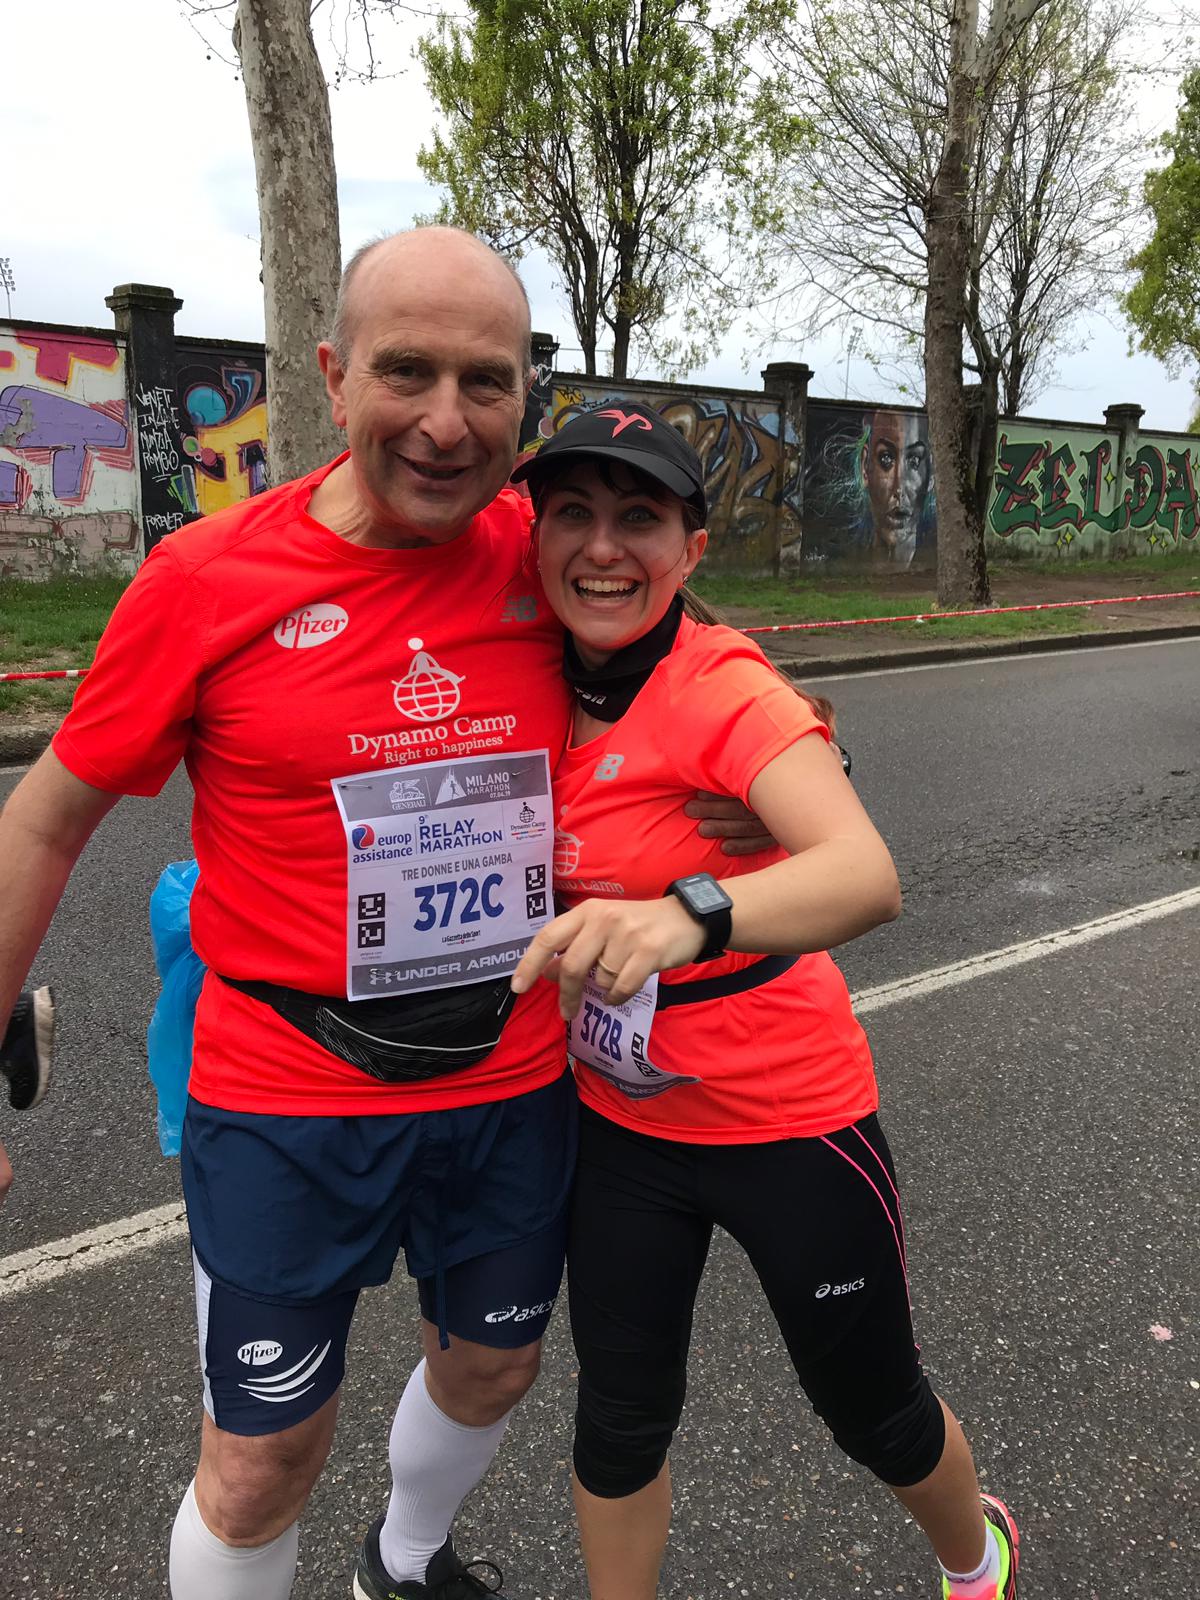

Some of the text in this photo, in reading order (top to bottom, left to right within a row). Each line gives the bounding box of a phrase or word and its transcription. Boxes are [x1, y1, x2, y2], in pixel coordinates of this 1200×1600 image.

[990, 433, 1200, 543] ZELDA
[280, 610, 346, 649] Pfizer
[348, 713, 517, 759] Dynamo Camp
[384, 735, 504, 765] Right to happiness
[465, 771, 510, 788] MILANO
[467, 783, 511, 796] MARATHON
[377, 832, 412, 847] europ
[419, 818, 475, 841] RELAY
[420, 829, 503, 855] MARATHON
[352, 846, 413, 864] assistance
[401, 852, 513, 881] TRE DONNE E UNA GAMBA
[413, 872, 505, 932] 372C
[396, 947, 530, 981] UNDER ARMOU
[580, 1000, 622, 1062] 372B
[832, 1277, 865, 1296] asics
[241, 1344, 282, 1365] Pfizer
